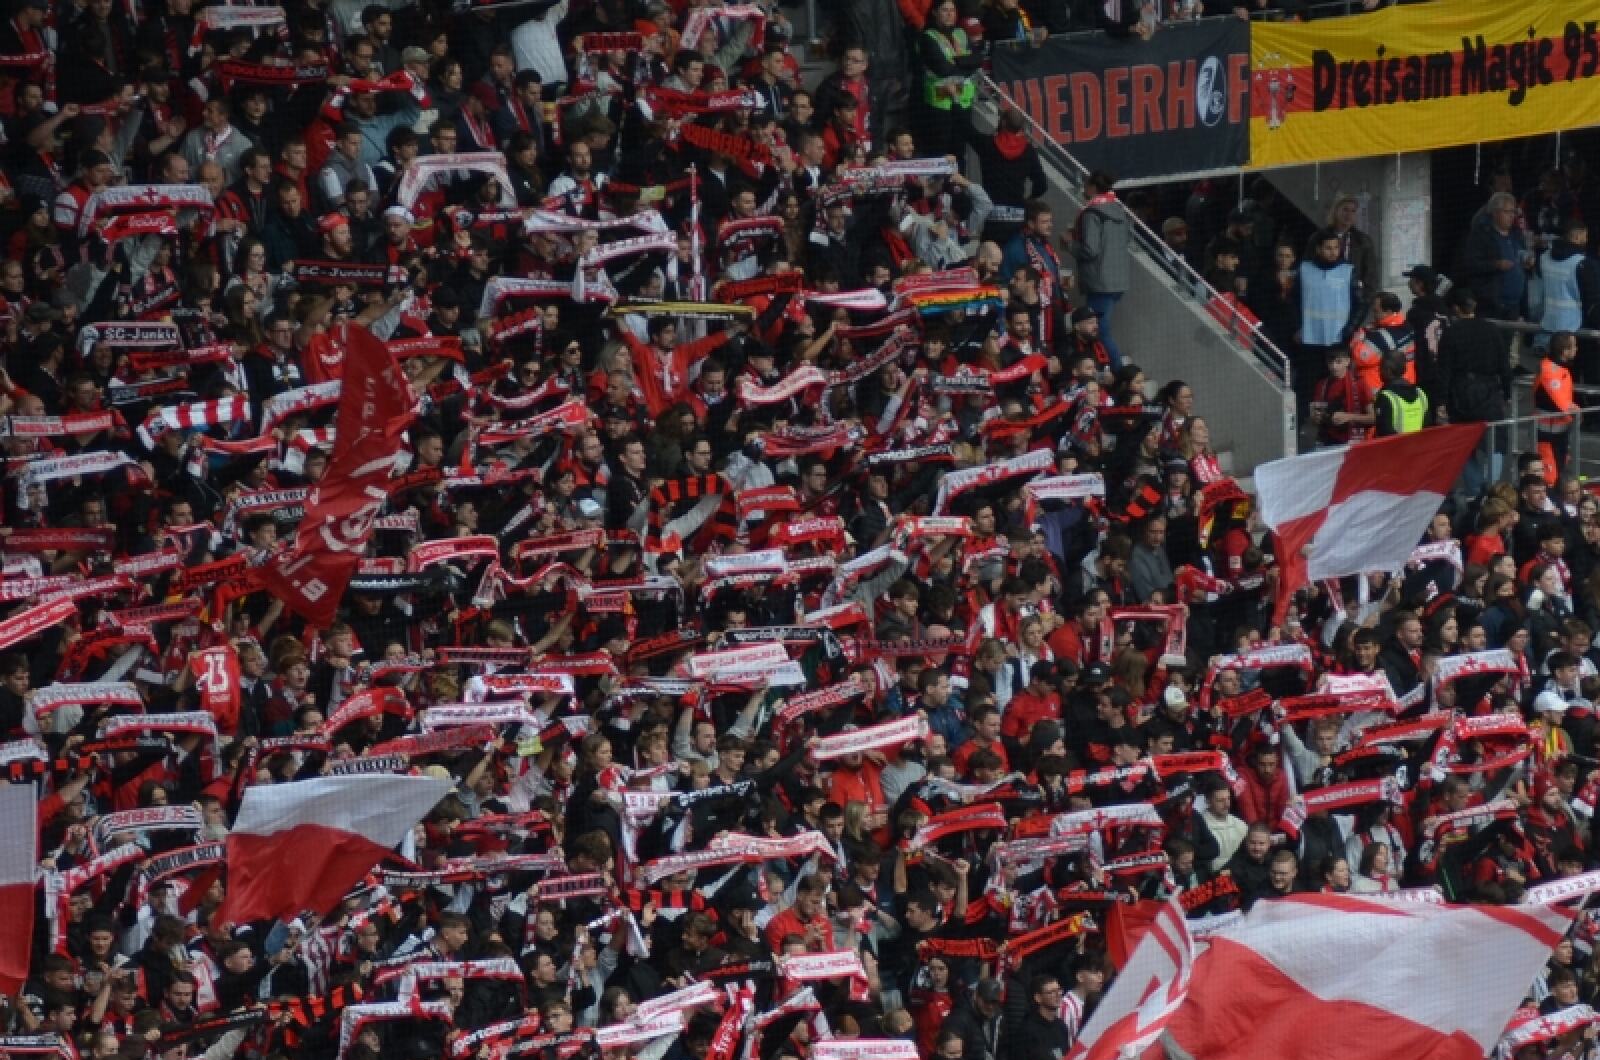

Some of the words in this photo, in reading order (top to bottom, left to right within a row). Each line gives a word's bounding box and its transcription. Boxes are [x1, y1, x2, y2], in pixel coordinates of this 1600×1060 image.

[1312, 44, 1453, 112] Dreisam
[1461, 26, 1554, 106] Magic
[1564, 20, 1599, 82] 95
